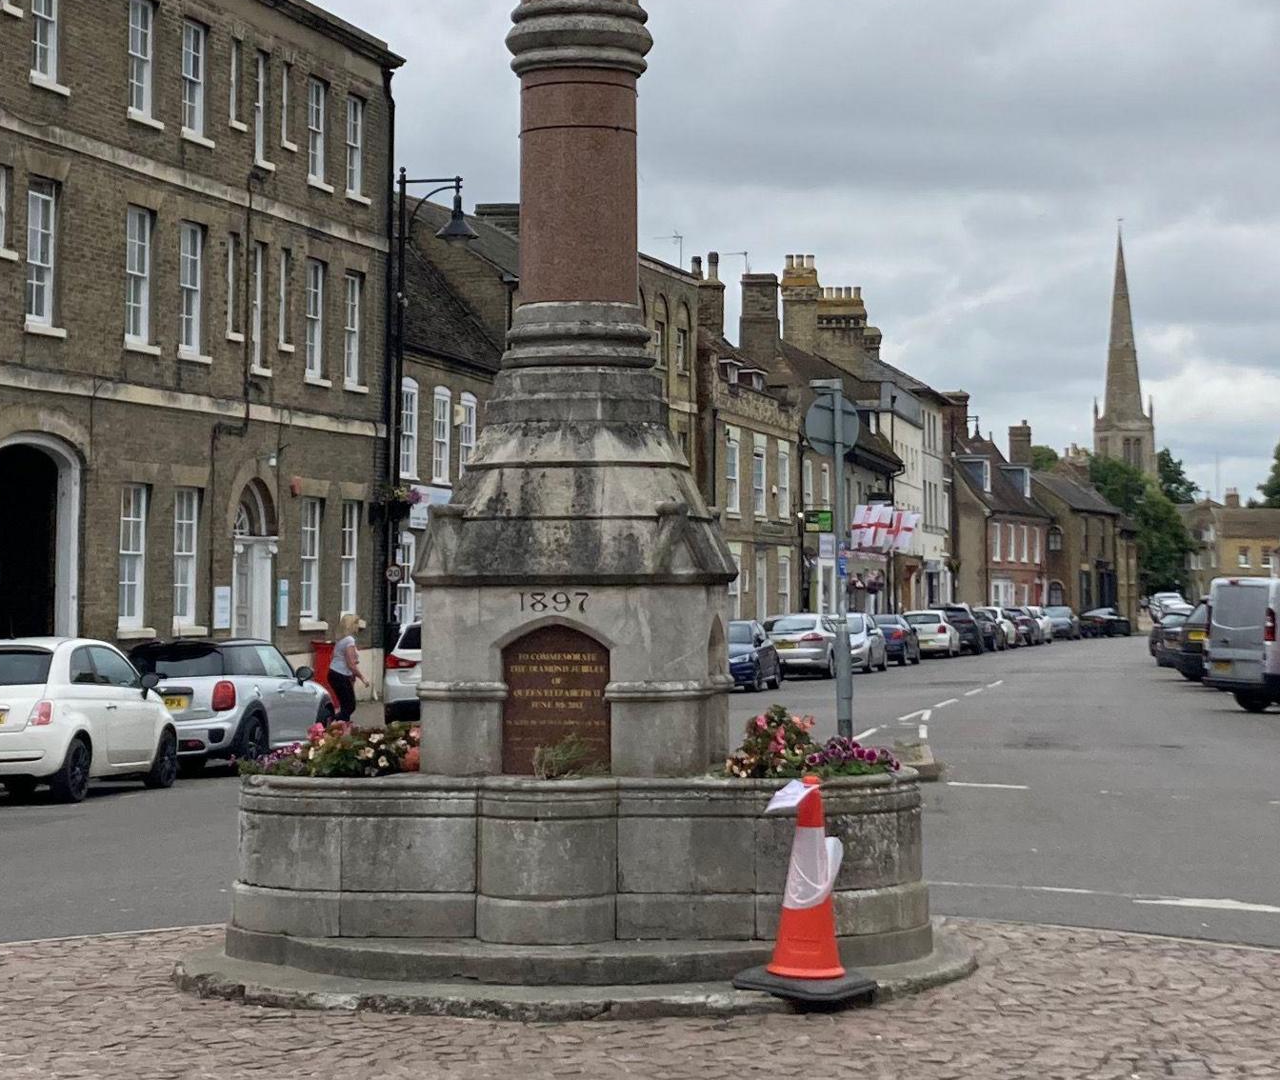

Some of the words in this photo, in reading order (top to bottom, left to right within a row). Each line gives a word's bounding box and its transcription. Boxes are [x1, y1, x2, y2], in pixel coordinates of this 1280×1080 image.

[387, 569, 400, 578] 20
[519, 591, 589, 614] 1897
[530, 652, 597, 661] COMMEMORATE
[528, 664, 569, 673] DIAMOND
[570, 664, 605, 673] JUBILEE
[513, 688, 543, 698] QUEEN
[544, 688, 592, 697] ELIZABETH
